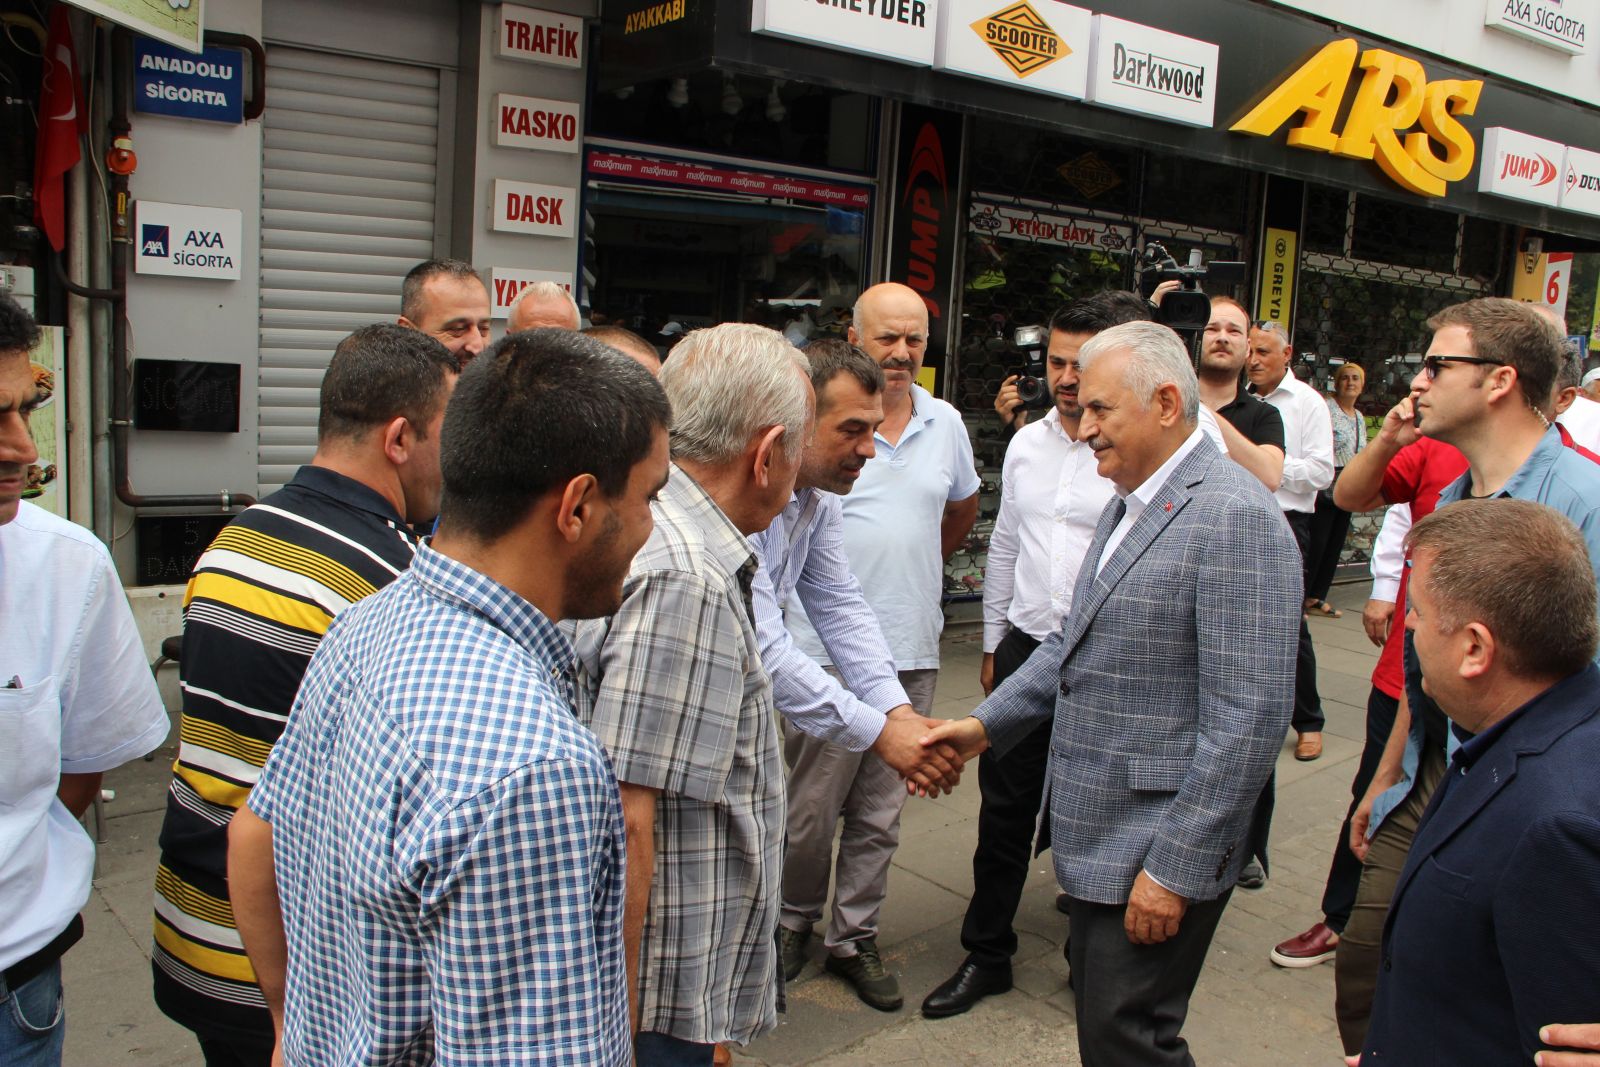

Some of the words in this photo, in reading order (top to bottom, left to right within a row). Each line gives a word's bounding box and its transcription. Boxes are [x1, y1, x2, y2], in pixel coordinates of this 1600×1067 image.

[623, 0, 686, 35] AYAKKABI
[1504, 0, 1531, 22] AXA
[1534, 6, 1585, 42] SİGORTA
[505, 19, 579, 59] TRAFİK
[985, 21, 1058, 56] SCOOTER
[140, 54, 233, 80] ANADOLU
[1113, 42, 1205, 99] Darkwood
[145, 80, 228, 107] SİGORTA
[501, 105, 577, 142] KASKO
[1228, 38, 1484, 197] ARS
[1500, 153, 1540, 180] JUMP
[506, 192, 564, 226] DASK
[142, 240, 165, 255] AXA
[184, 230, 224, 249] AXA
[173, 250, 233, 269] SİGORTA
[1546, 270, 1560, 305] 6
[184, 520, 200, 545] 5
